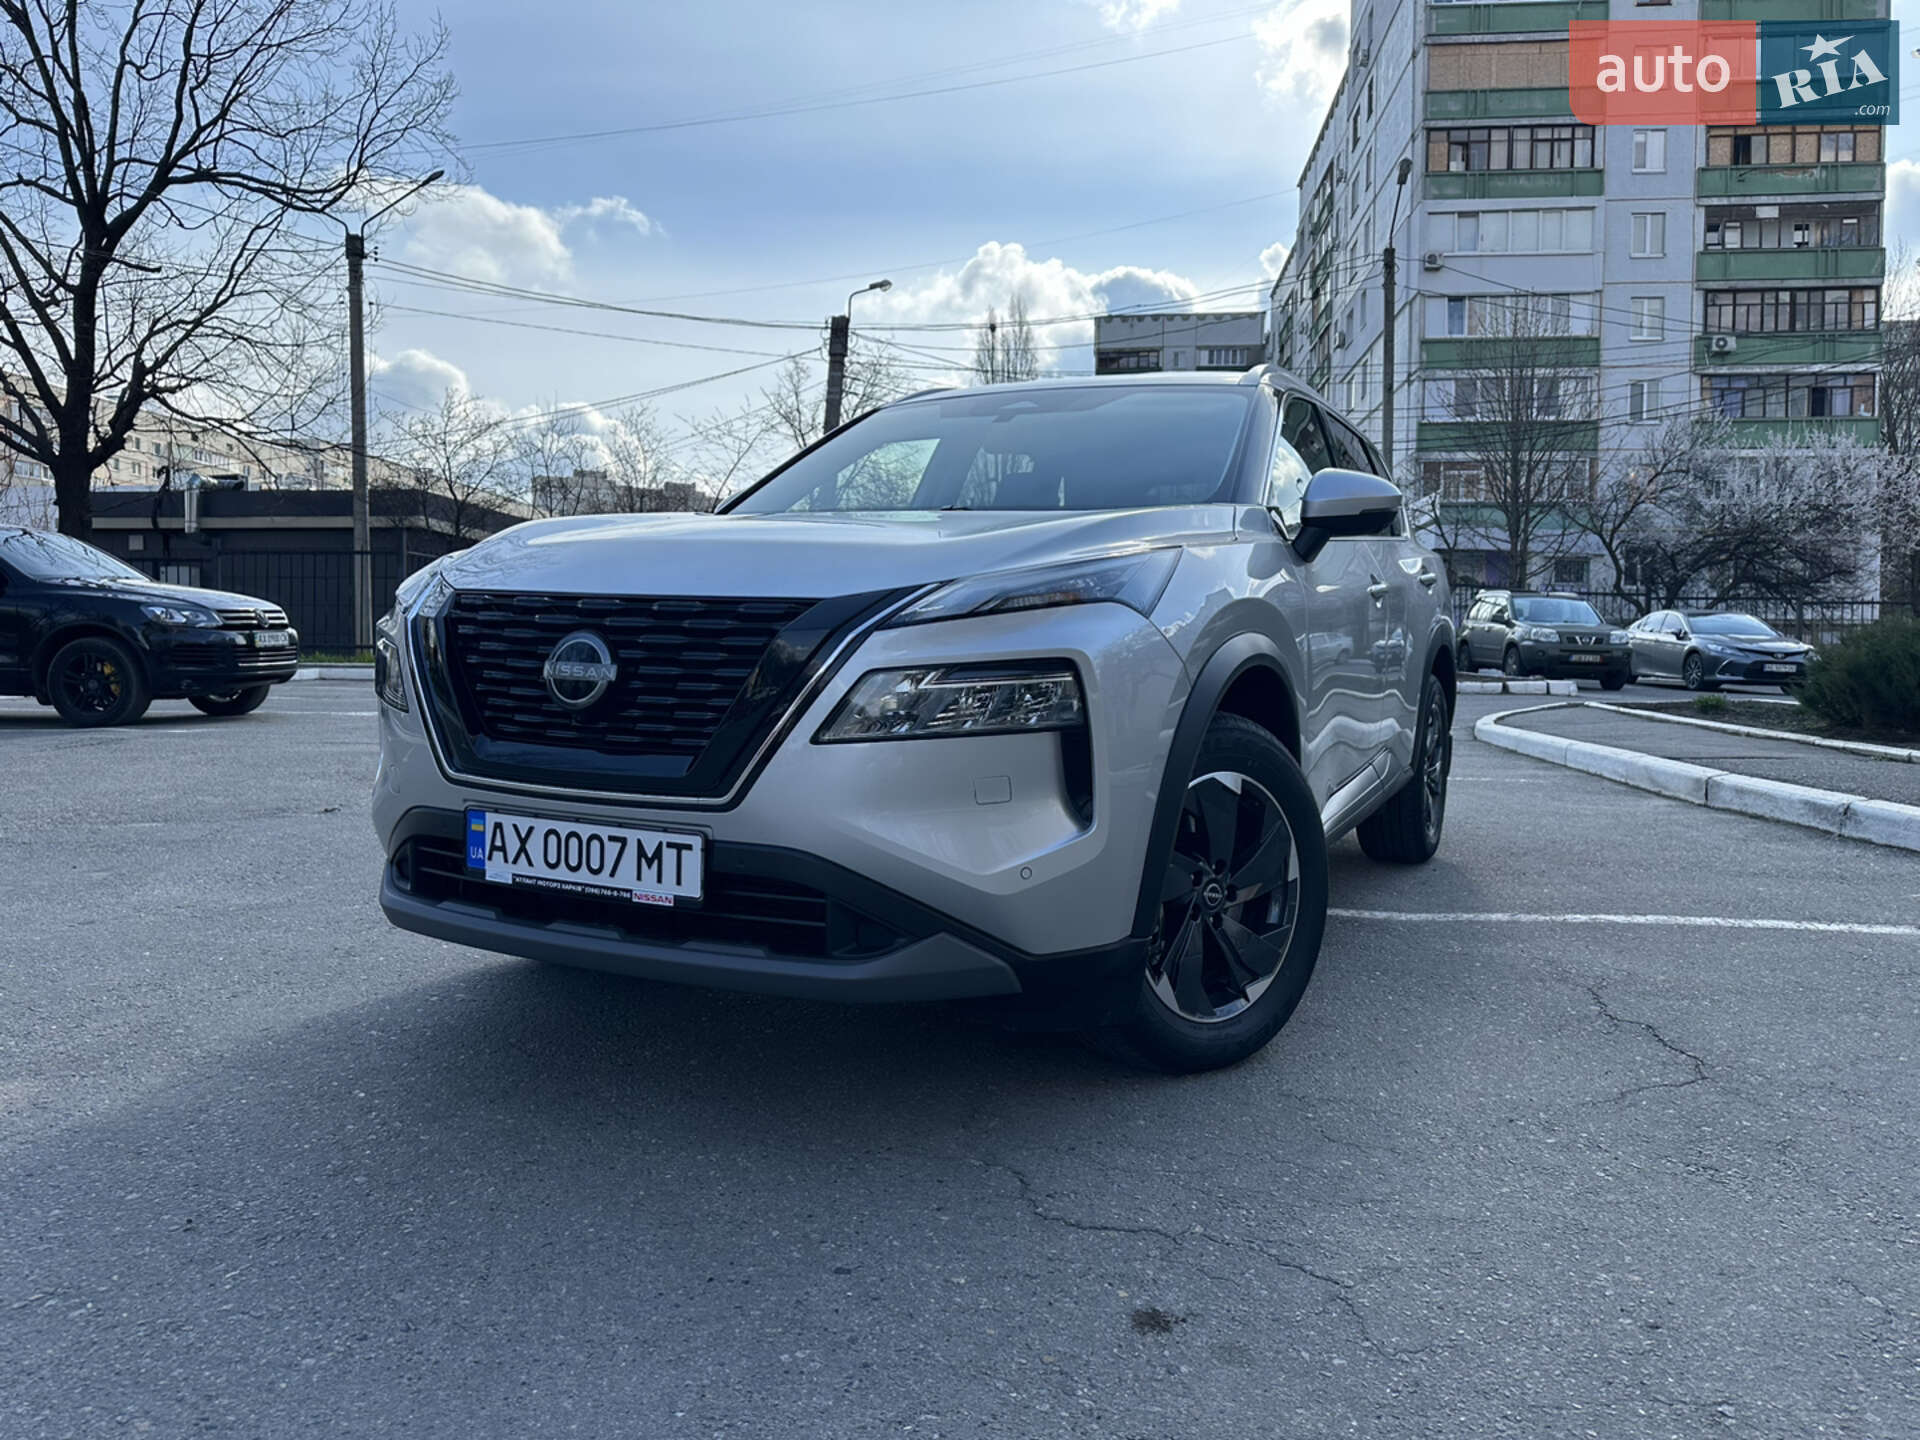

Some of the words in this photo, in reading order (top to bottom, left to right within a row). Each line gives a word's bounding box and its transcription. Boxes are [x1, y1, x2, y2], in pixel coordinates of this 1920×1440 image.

[543, 662, 615, 681] NISSAN
[470, 846, 484, 861] UA
[487, 821, 535, 868] AX
[543, 828, 628, 878] 0007
[635, 838, 694, 887] MT
[634, 892, 672, 904] NISSAN
